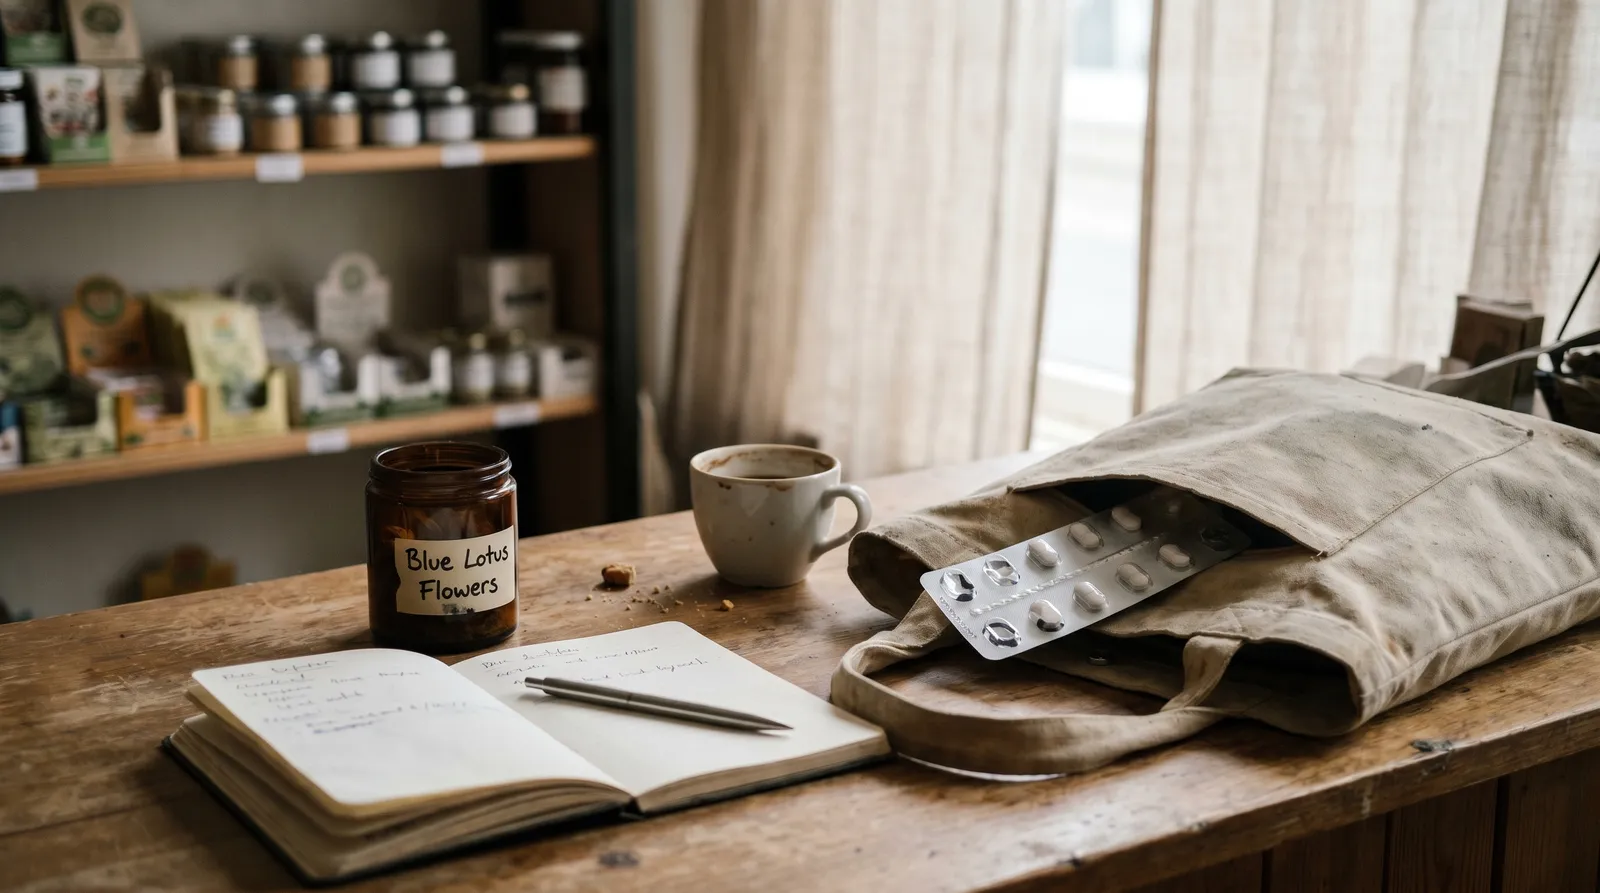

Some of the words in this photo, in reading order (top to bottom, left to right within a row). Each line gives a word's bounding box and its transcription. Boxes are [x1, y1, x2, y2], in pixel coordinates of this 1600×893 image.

[405, 548, 454, 571] Blue
[464, 544, 509, 569] Lotus
[418, 577, 498, 600] Flowers
